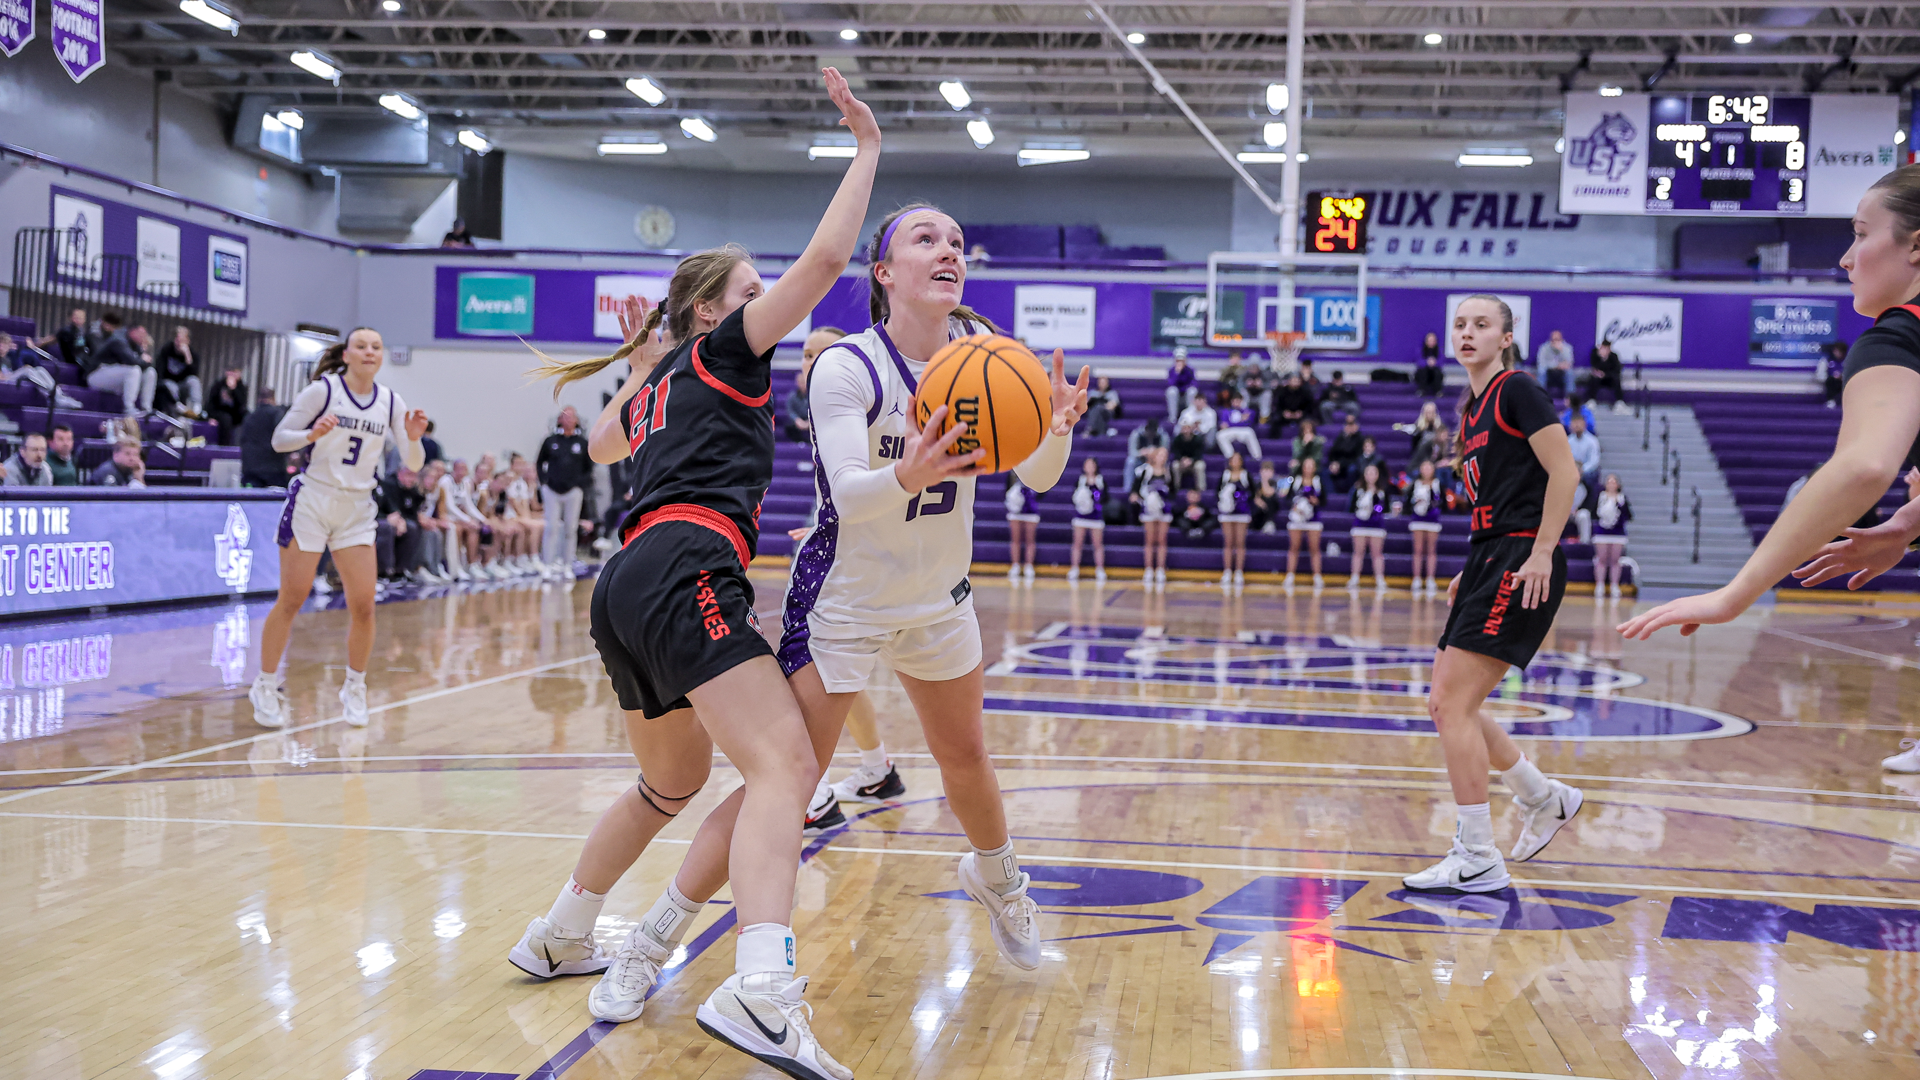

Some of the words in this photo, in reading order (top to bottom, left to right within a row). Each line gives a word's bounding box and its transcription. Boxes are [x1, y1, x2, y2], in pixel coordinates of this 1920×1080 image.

[0, 16, 20, 41] 016
[53, 5, 98, 43] FOOTBALL
[62, 37, 89, 67] 2016
[1708, 95, 1769, 124] 6:42
[1675, 142, 1694, 167] 4
[1786, 141, 1805, 170] 8
[1814, 145, 1875, 166] Avera
[1656, 177, 1671, 200] 2
[1788, 178, 1803, 202] 3
[1315, 216, 1357, 251] 24
[465, 294, 513, 314] Avera
[629, 367, 676, 462] 21
[342, 435, 362, 466] 3
[1463, 456, 1481, 505] 11
[18, 507, 38, 535] TO
[42, 506, 70, 535] THE
[0, 544, 20, 596] T
[25, 541, 115, 595] CENTER
[1483, 570, 1515, 636] HUSKIES
